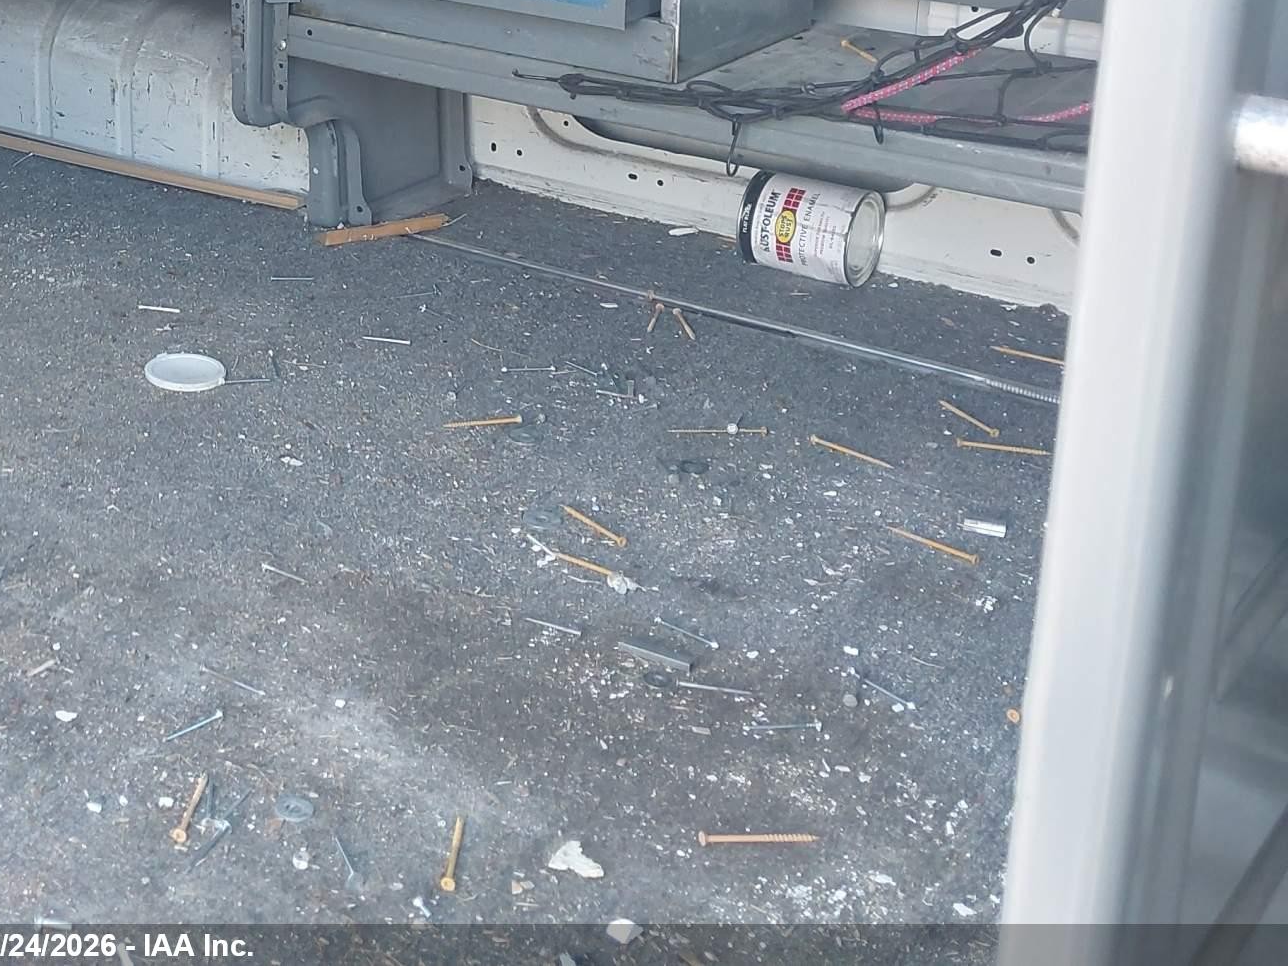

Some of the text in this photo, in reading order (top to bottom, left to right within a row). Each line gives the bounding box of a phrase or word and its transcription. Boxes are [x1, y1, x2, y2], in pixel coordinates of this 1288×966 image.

[759, 191, 782, 253] RUST-OLEUM
[803, 193, 821, 223] ENAMEL
[798, 224, 810, 267] PROTECTIVE
